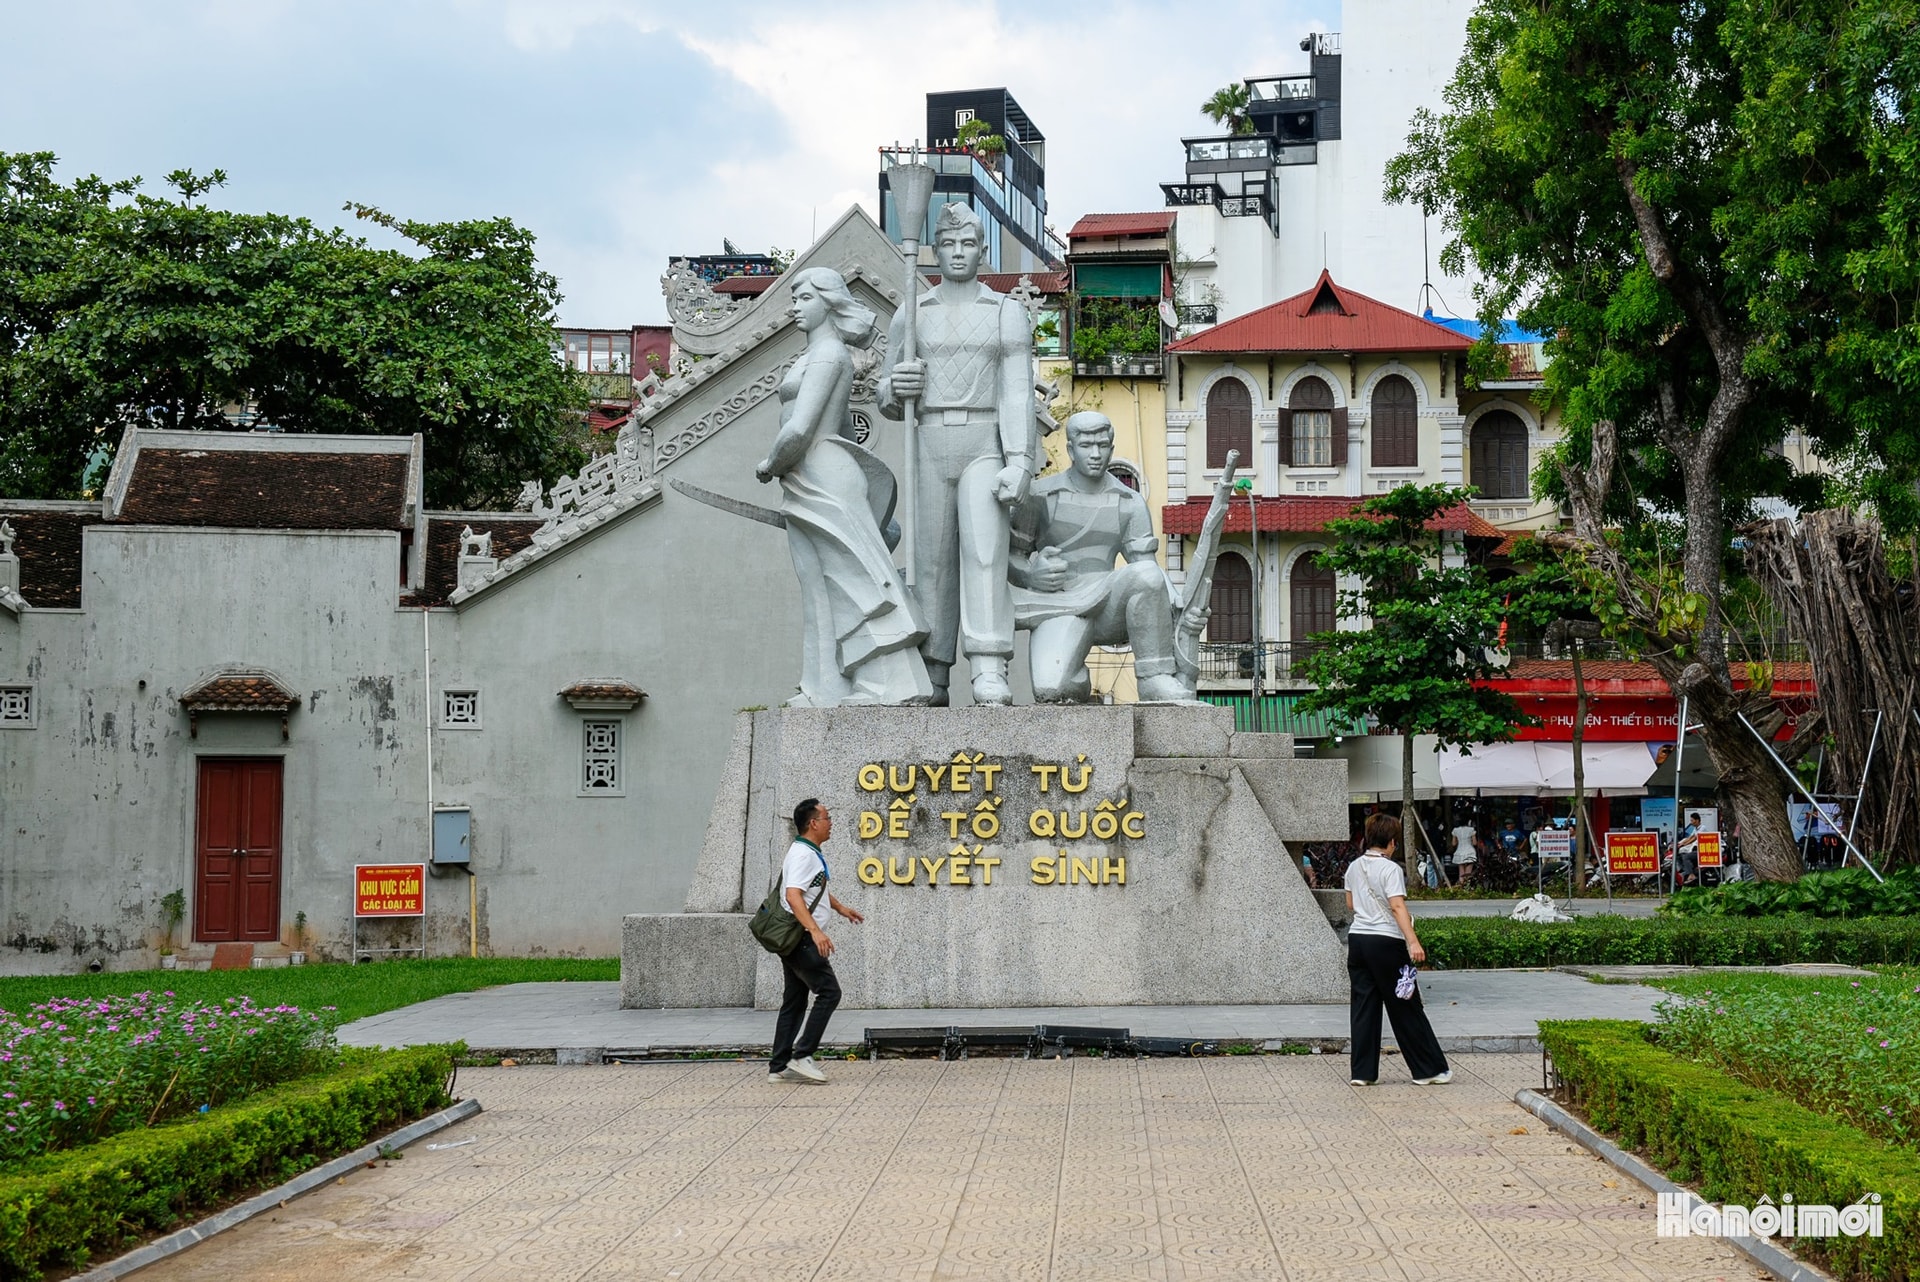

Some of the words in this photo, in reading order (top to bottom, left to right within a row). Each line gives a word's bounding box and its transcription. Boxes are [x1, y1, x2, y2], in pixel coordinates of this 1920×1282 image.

[935, 139, 949, 148] LA
[1550, 715, 1574, 728] PHỤ
[1583, 713, 1601, 728] IỆN
[1609, 711, 1642, 727] THIẾT
[1643, 715, 1655, 728] BỊ
[858, 752, 1002, 792] QUYẾT
[1031, 752, 1093, 793] TỬ
[858, 793, 917, 839] ĐỂ
[941, 796, 1002, 839] TỔ
[1028, 798, 1146, 839] QUỐC
[1610, 845, 1625, 858] KHU
[1625, 844, 1639, 861] VỰC
[1639, 841, 1655, 858] CẤM
[857, 843, 1001, 886] QUYẾT
[1030, 848, 1127, 886] SINH
[1613, 859, 1628, 870] CÁC
[1628, 860, 1643, 871] LOẠI
[1644, 861, 1654, 870] XE
[360, 880, 378, 897] KHU
[380, 879, 397, 899] VỰC
[399, 874, 420, 896] CẤM
[363, 898, 381, 910] CÁC
[383, 899, 403, 912] LOẠI
[404, 899, 417, 910] XE
